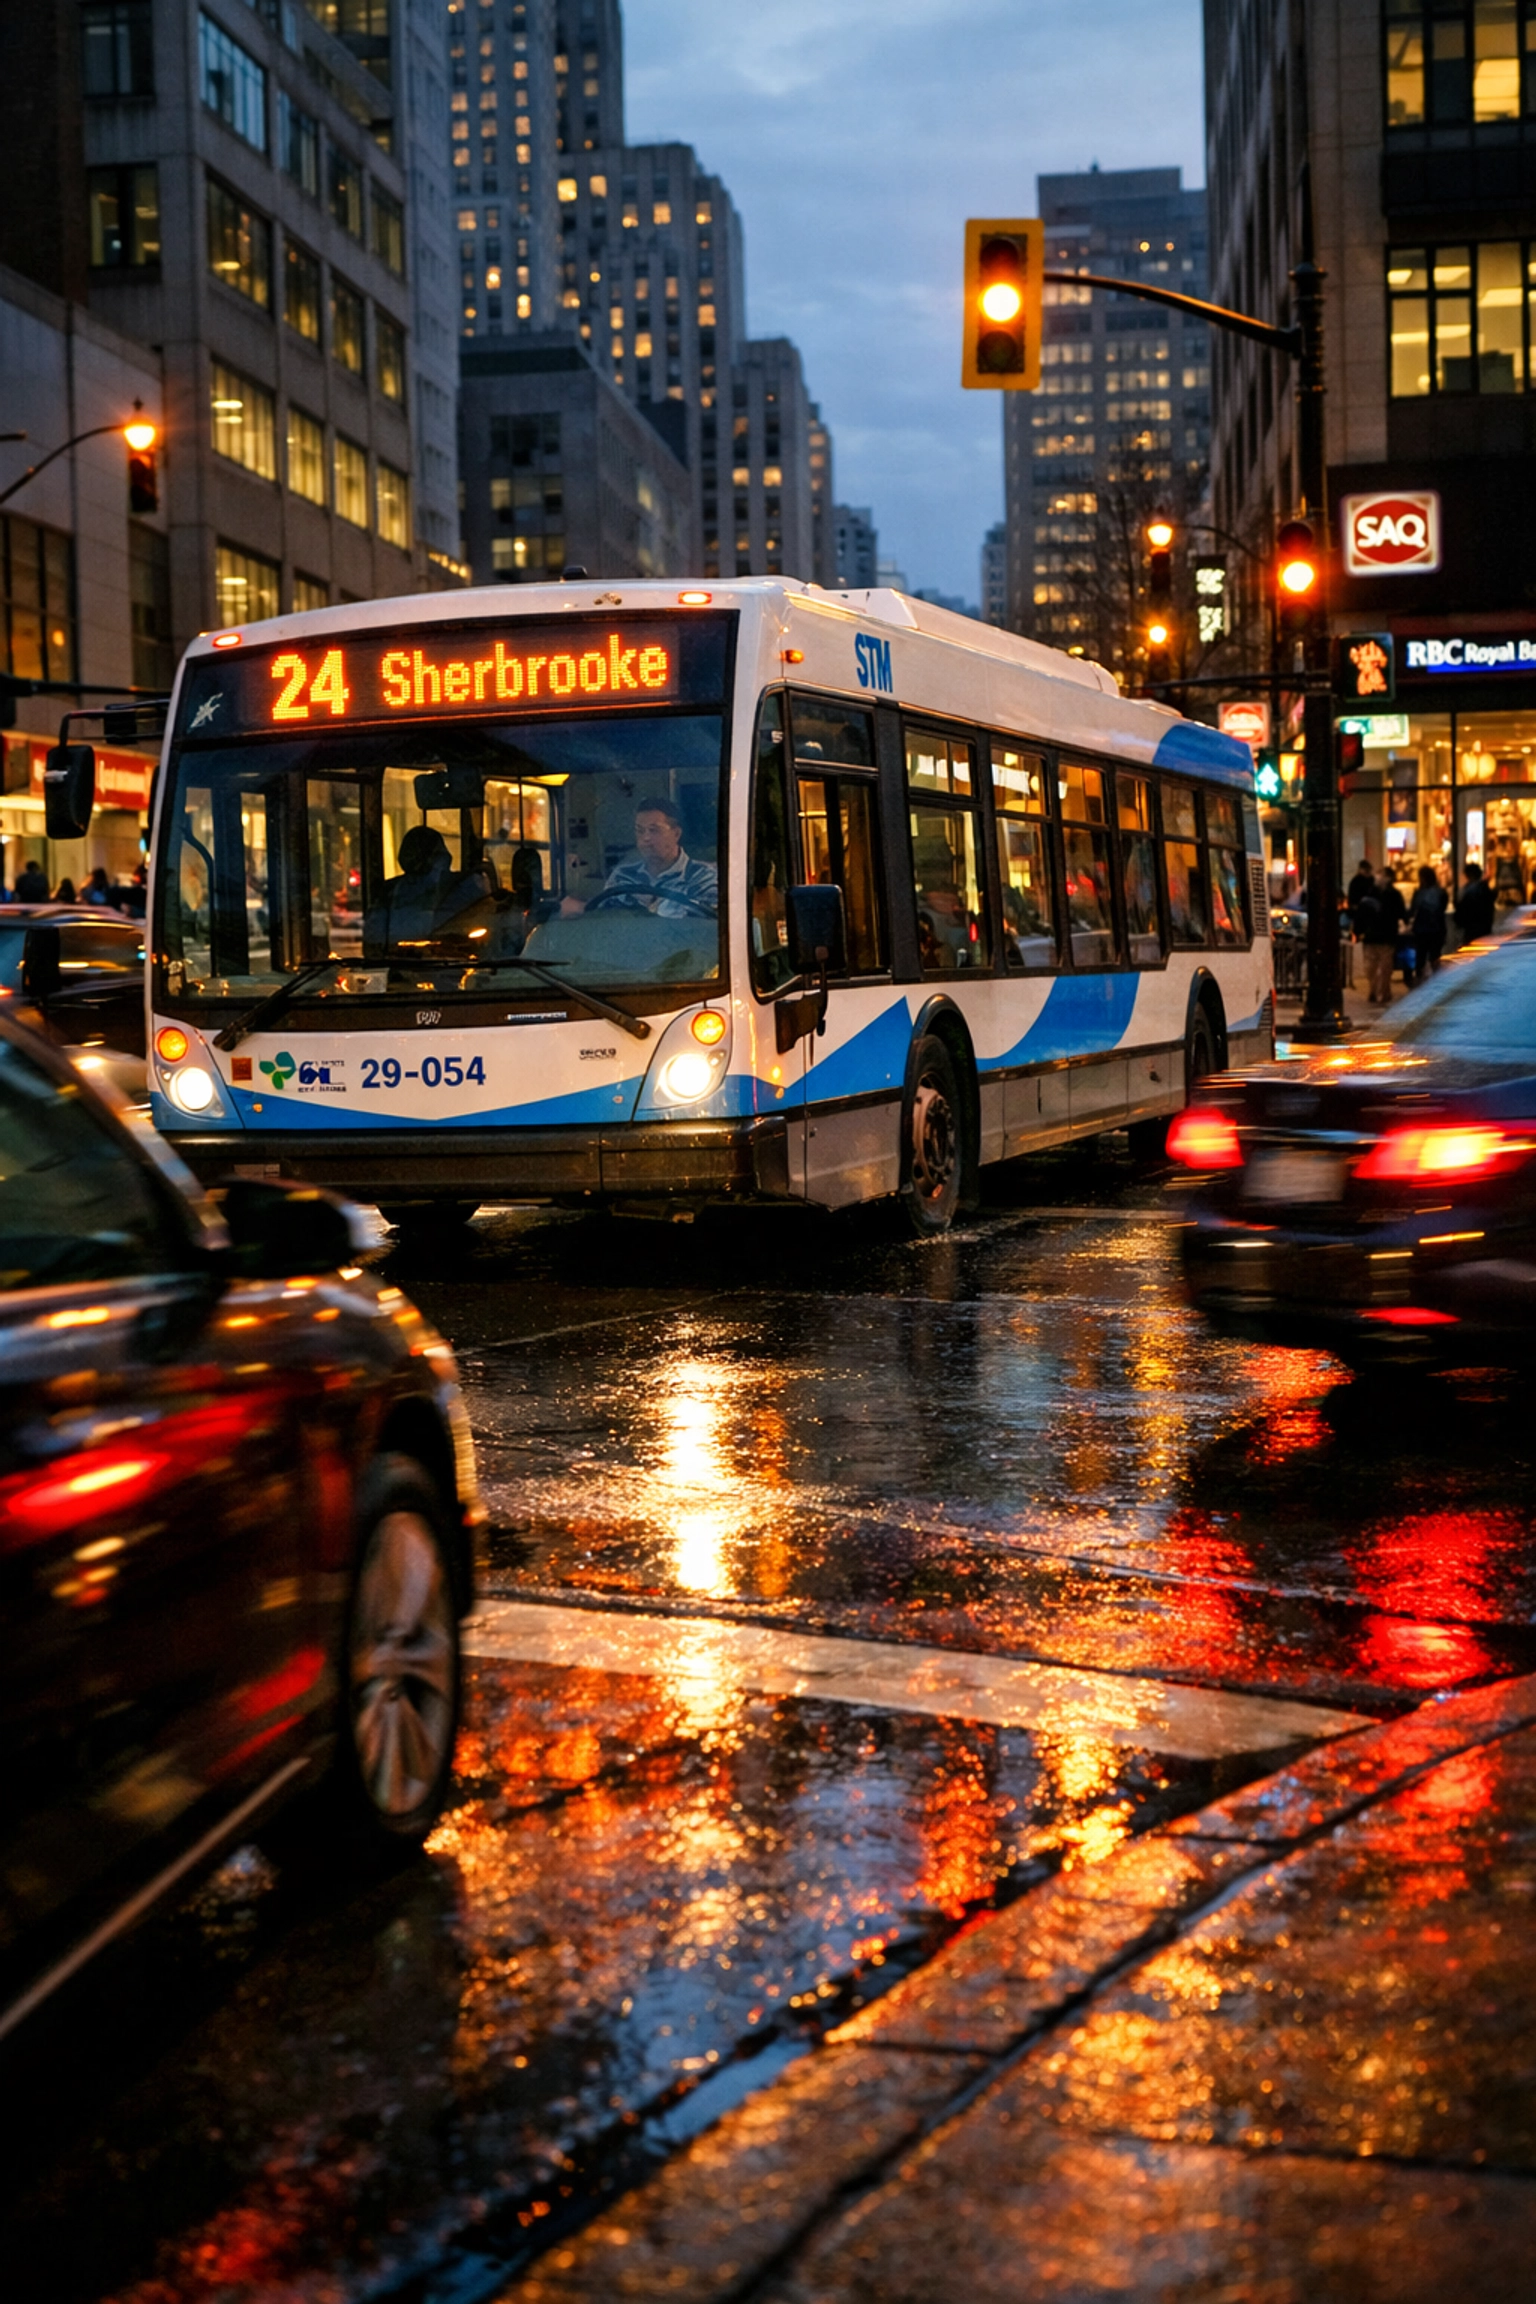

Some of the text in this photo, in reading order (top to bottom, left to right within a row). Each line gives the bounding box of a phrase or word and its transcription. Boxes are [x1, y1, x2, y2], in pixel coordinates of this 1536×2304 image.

[1357, 513, 1426, 549] SAQ
[854, 632, 893, 694] STM
[1406, 638, 1464, 668] RBC
[1464, 641, 1515, 667] Royal
[271, 634, 668, 721] 24 Sherbrooke
[360, 1056, 487, 1089] 29-054
